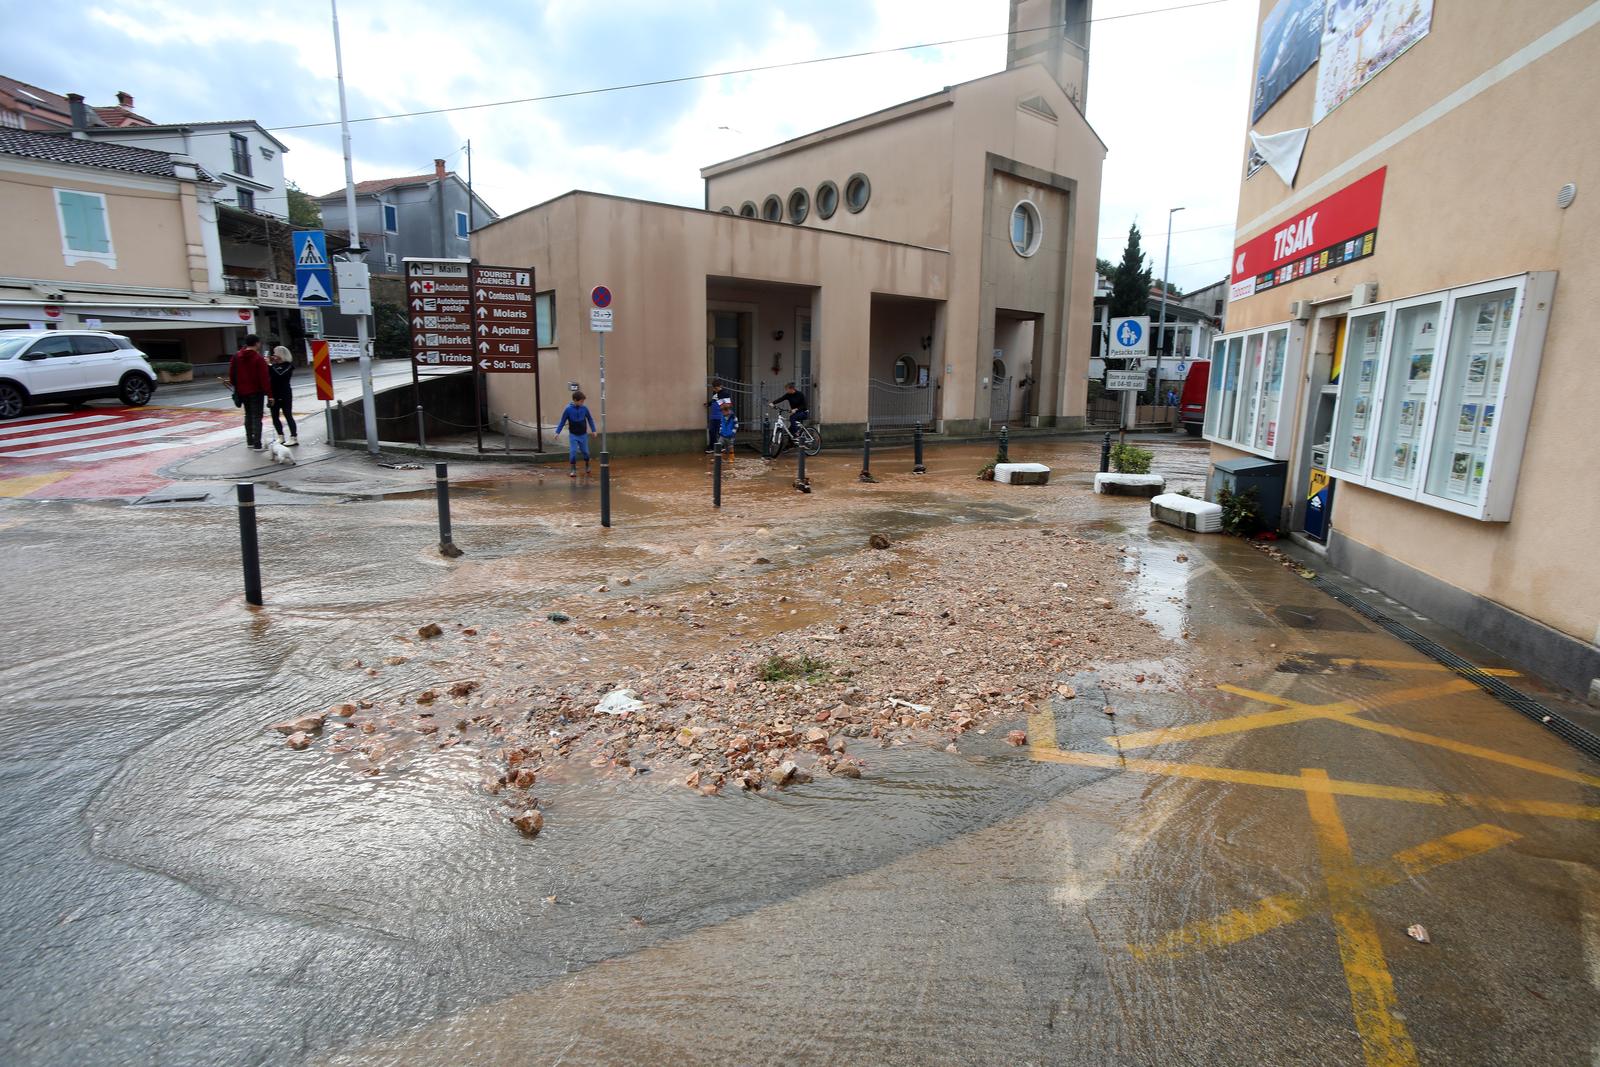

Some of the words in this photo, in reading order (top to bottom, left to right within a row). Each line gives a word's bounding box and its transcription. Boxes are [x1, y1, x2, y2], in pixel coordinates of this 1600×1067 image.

[1273, 211, 1319, 261] TISAK
[439, 265, 461, 273] Malin
[479, 270, 512, 278] TOURIST
[476, 277, 515, 286] AGENCIES
[435, 282, 468, 292] Ambulanta
[488, 291, 515, 301] Contessa
[516, 292, 531, 302] Villas
[441, 305, 465, 313] postaja
[493, 308, 528, 318] Molaris
[492, 326, 530, 337] Apolinar
[438, 335, 471, 345] Market
[499, 343, 520, 354] Kralj
[440, 353, 472, 362] Tržnica
